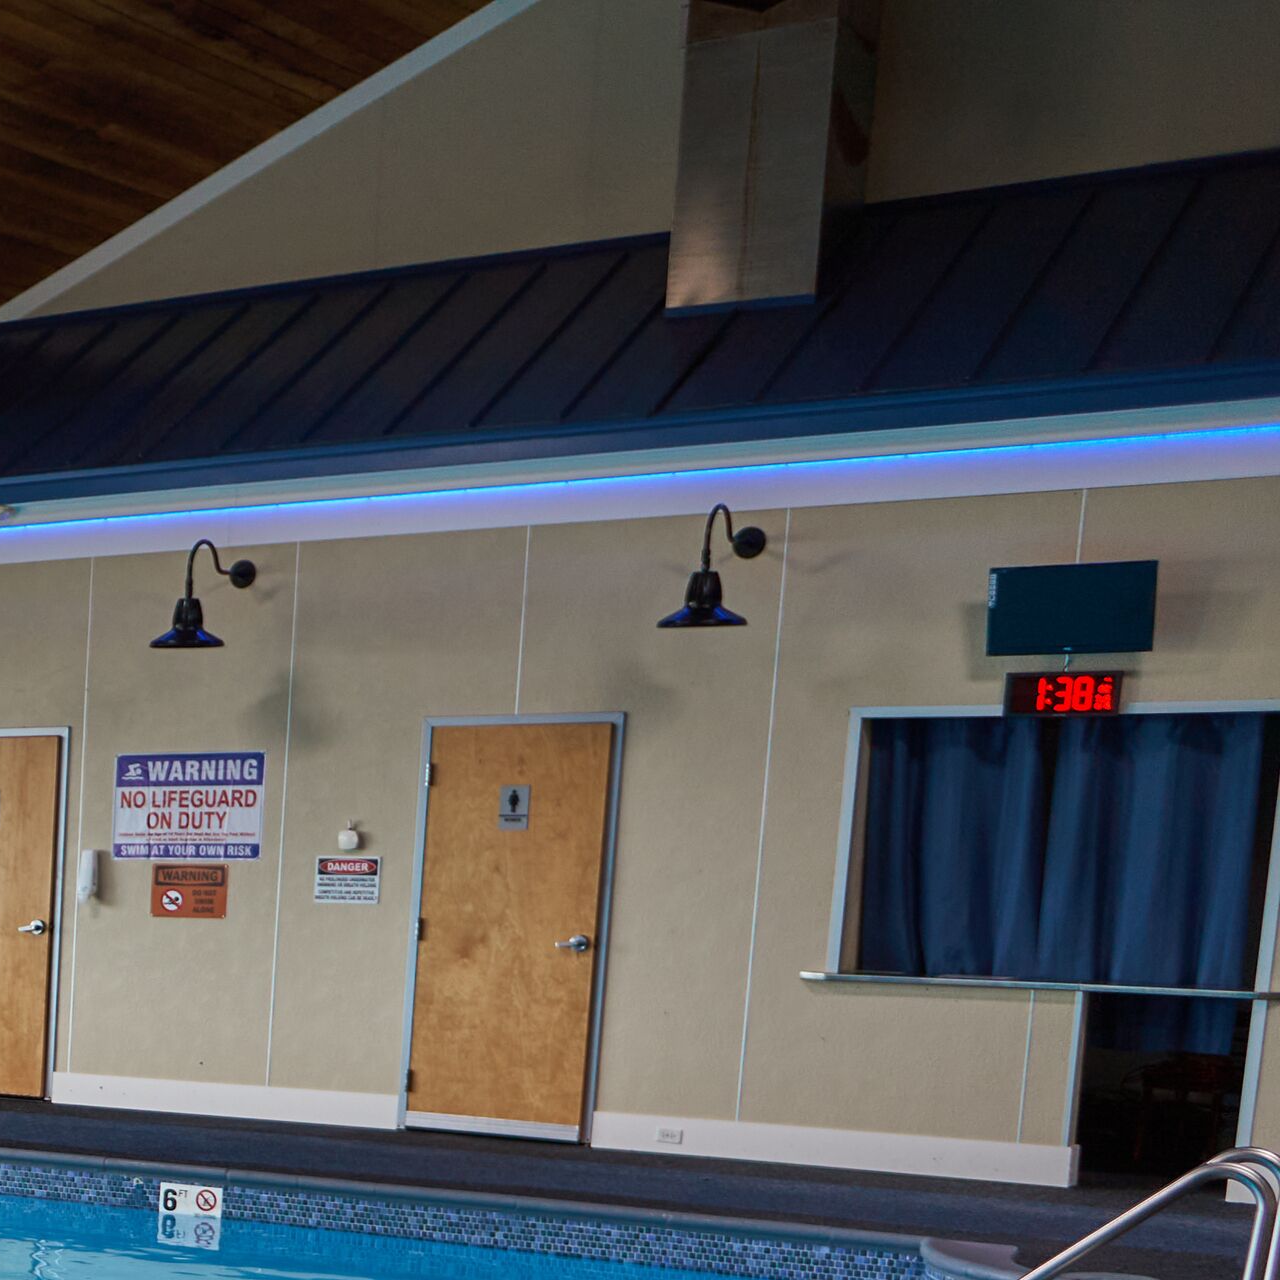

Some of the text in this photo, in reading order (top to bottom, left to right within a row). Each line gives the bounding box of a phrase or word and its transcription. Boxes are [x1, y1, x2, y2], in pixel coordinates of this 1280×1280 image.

[1036, 676, 1095, 711] 1:38
[147, 759, 258, 781] WARNING
[120, 790, 257, 808] NO LIFEGUARD
[146, 811, 227, 829] ON DUTY
[120, 845, 252, 856] SWIM AT YOUR OWN RISK
[161, 870, 218, 881] WARNING
[327, 862, 369, 871] DANGER
[163, 1188, 188, 1211] 6 FT
